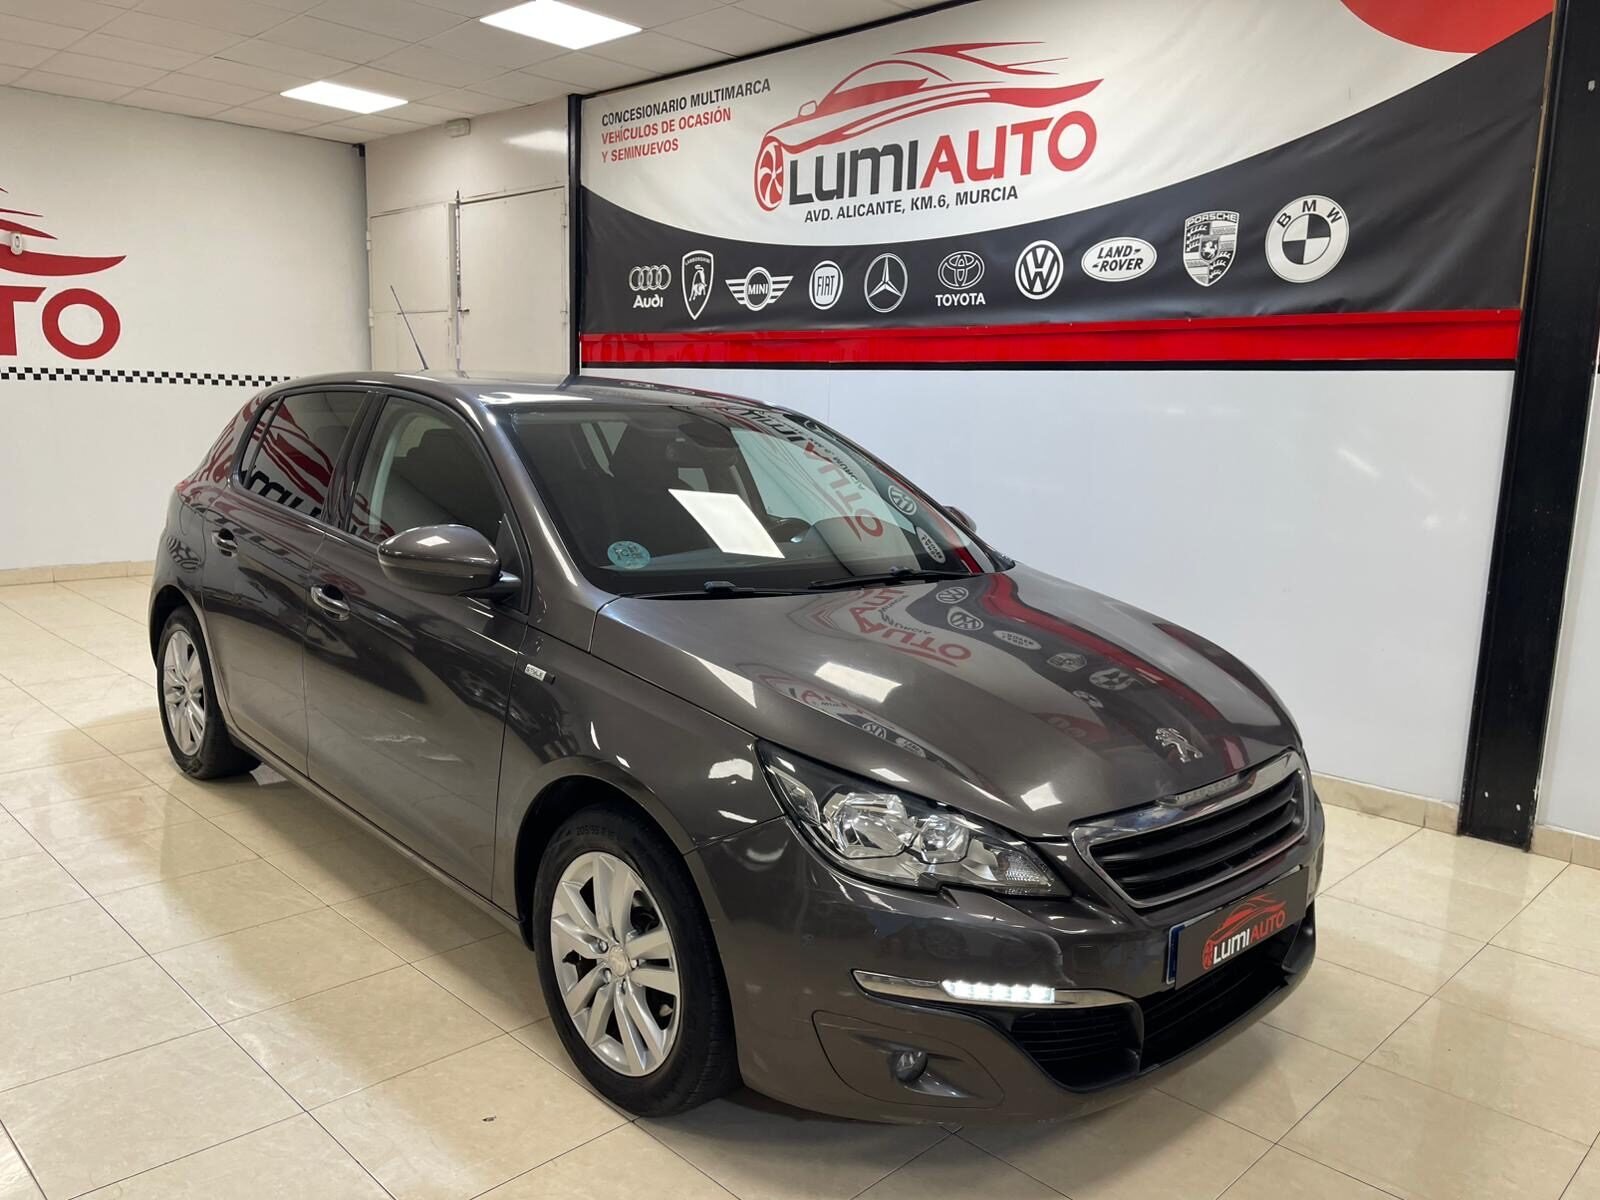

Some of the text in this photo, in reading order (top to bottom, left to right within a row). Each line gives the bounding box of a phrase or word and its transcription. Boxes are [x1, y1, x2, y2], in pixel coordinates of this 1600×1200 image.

[601, 78, 771, 127] CONCESIONARIO MULTIMARCA
[601, 106, 732, 145] VEHÍCULOS DE OCASIÓN
[601, 138, 679, 163] Y SEMINUEVOS
[804, 185, 1018, 223] AVD. ALICANTE, KM.6, MURCIA
[1276, 199, 1343, 229] BMW
[1187, 212, 1238, 228] PORSCHE
[1098, 257, 1144, 273] ROVER
[748, 282, 770, 296] MINI
[817, 274, 836, 297] FIAT
[633, 294, 664, 309] Audi
[935, 292, 986, 307] TOYOTA
